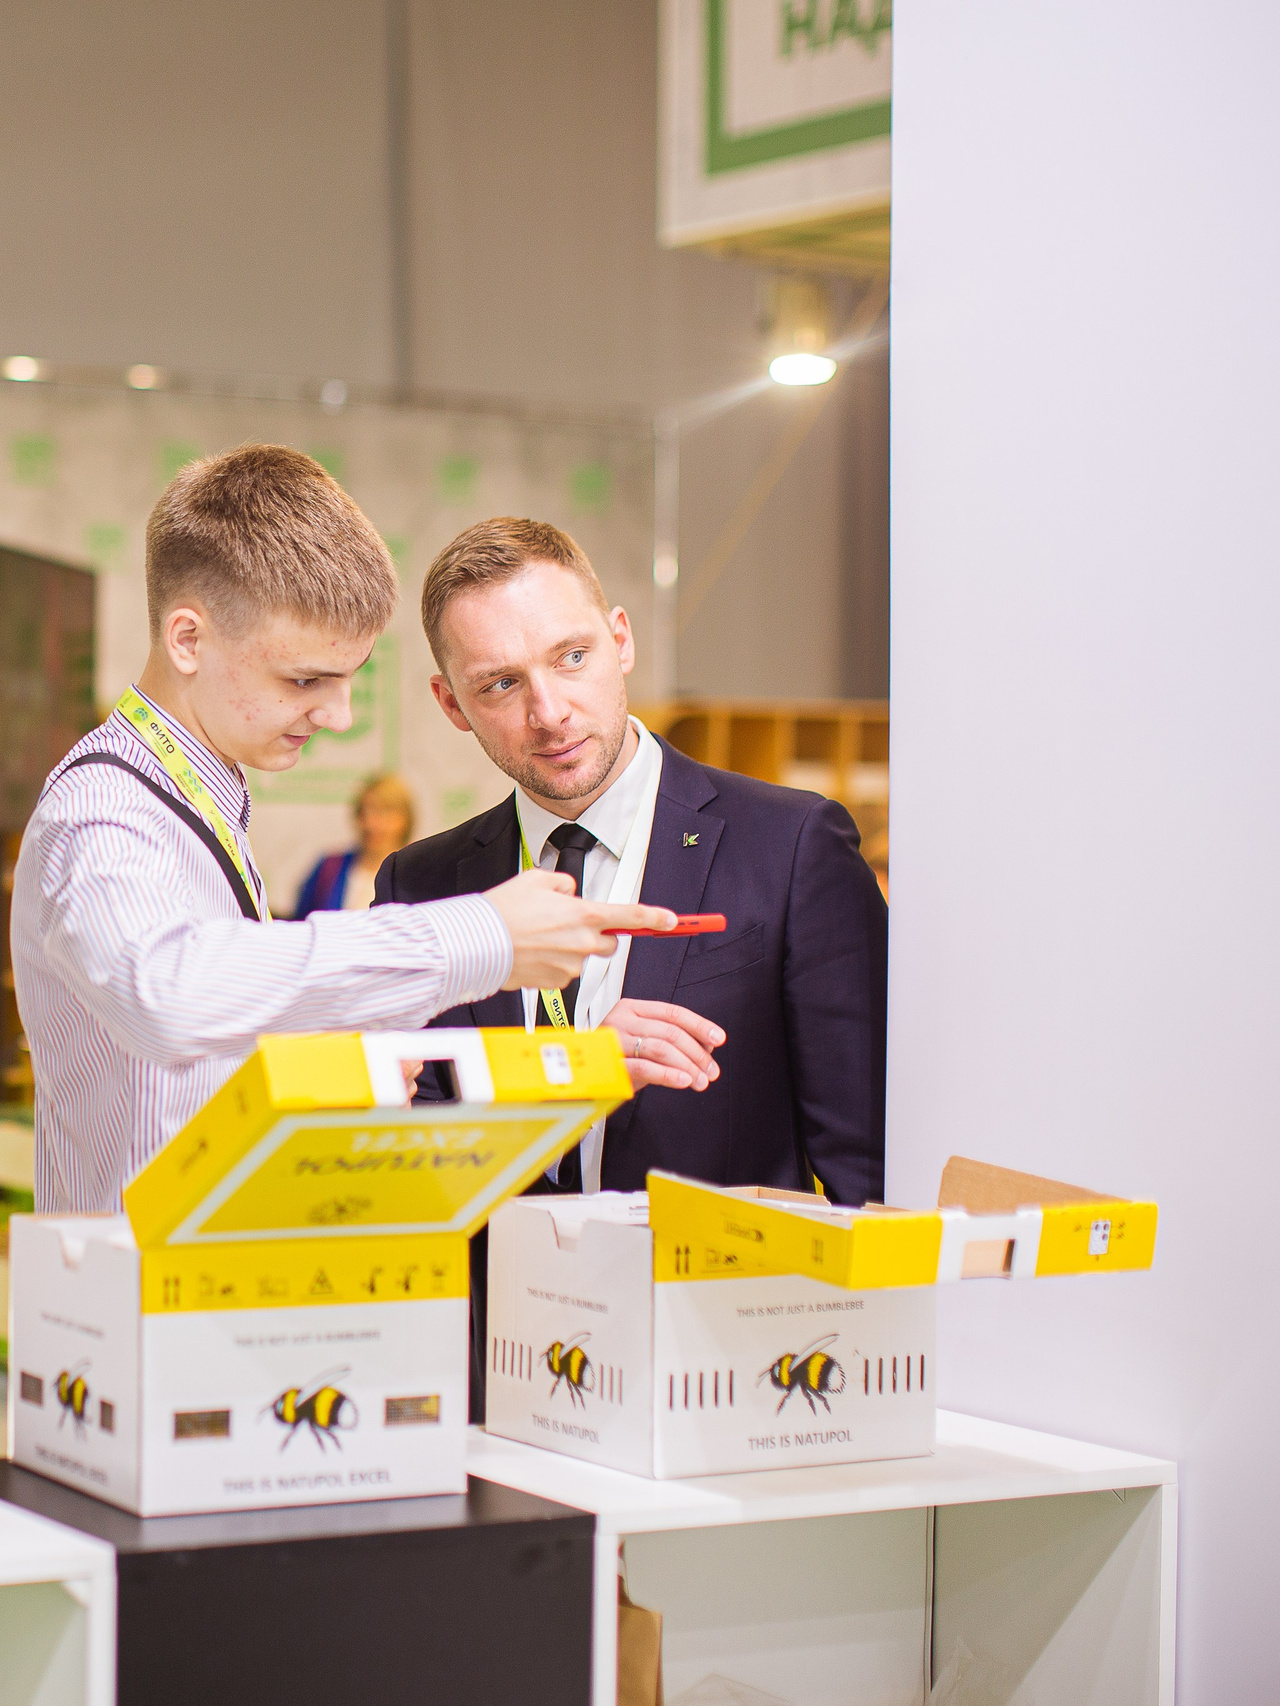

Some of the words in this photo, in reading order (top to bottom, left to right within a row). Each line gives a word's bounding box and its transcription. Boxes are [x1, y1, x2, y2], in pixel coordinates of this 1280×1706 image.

[150, 722, 175, 755] ФИТО
[552, 998, 566, 1029] ФИТО
[736, 1308, 756, 1318] THIS
[757, 1307, 765, 1317] IS
[766, 1306, 784, 1316] NOT
[787, 1304, 806, 1315] JUST
[816, 1300, 865, 1312] BUMBLEBEE
[532, 1414, 550, 1431] THIS
[552, 1420, 560, 1433] IS
[562, 1422, 601, 1445] NATUPOL
[748, 1437, 776, 1450] THIS
[780, 1435, 791, 1448] IS
[795, 1429, 854, 1446] NATUPOL
[349, 1468, 392, 1486] EXCEL
